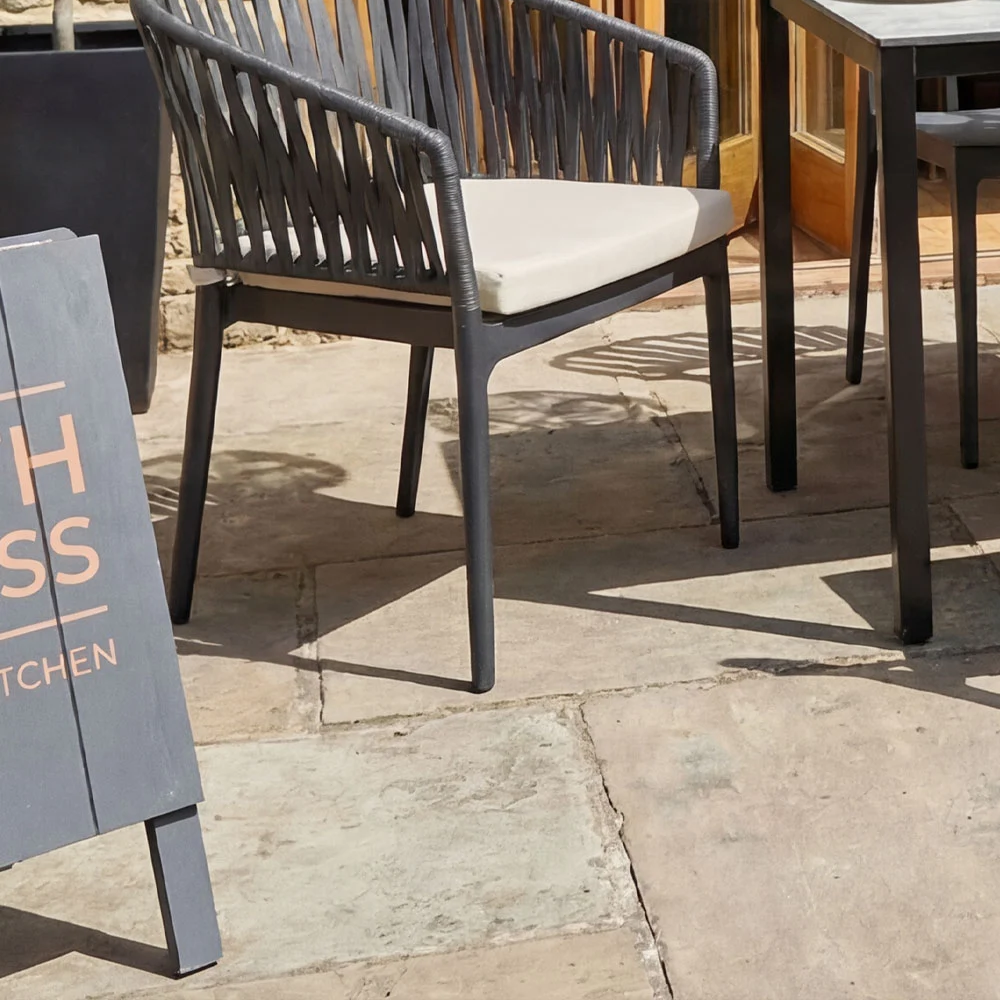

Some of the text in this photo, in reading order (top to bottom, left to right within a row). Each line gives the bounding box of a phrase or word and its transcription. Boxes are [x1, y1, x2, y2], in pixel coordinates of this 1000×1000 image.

[0, 413, 86, 506] H
[0, 516, 100, 598] SS
[0, 638, 117, 697] TCHEN
